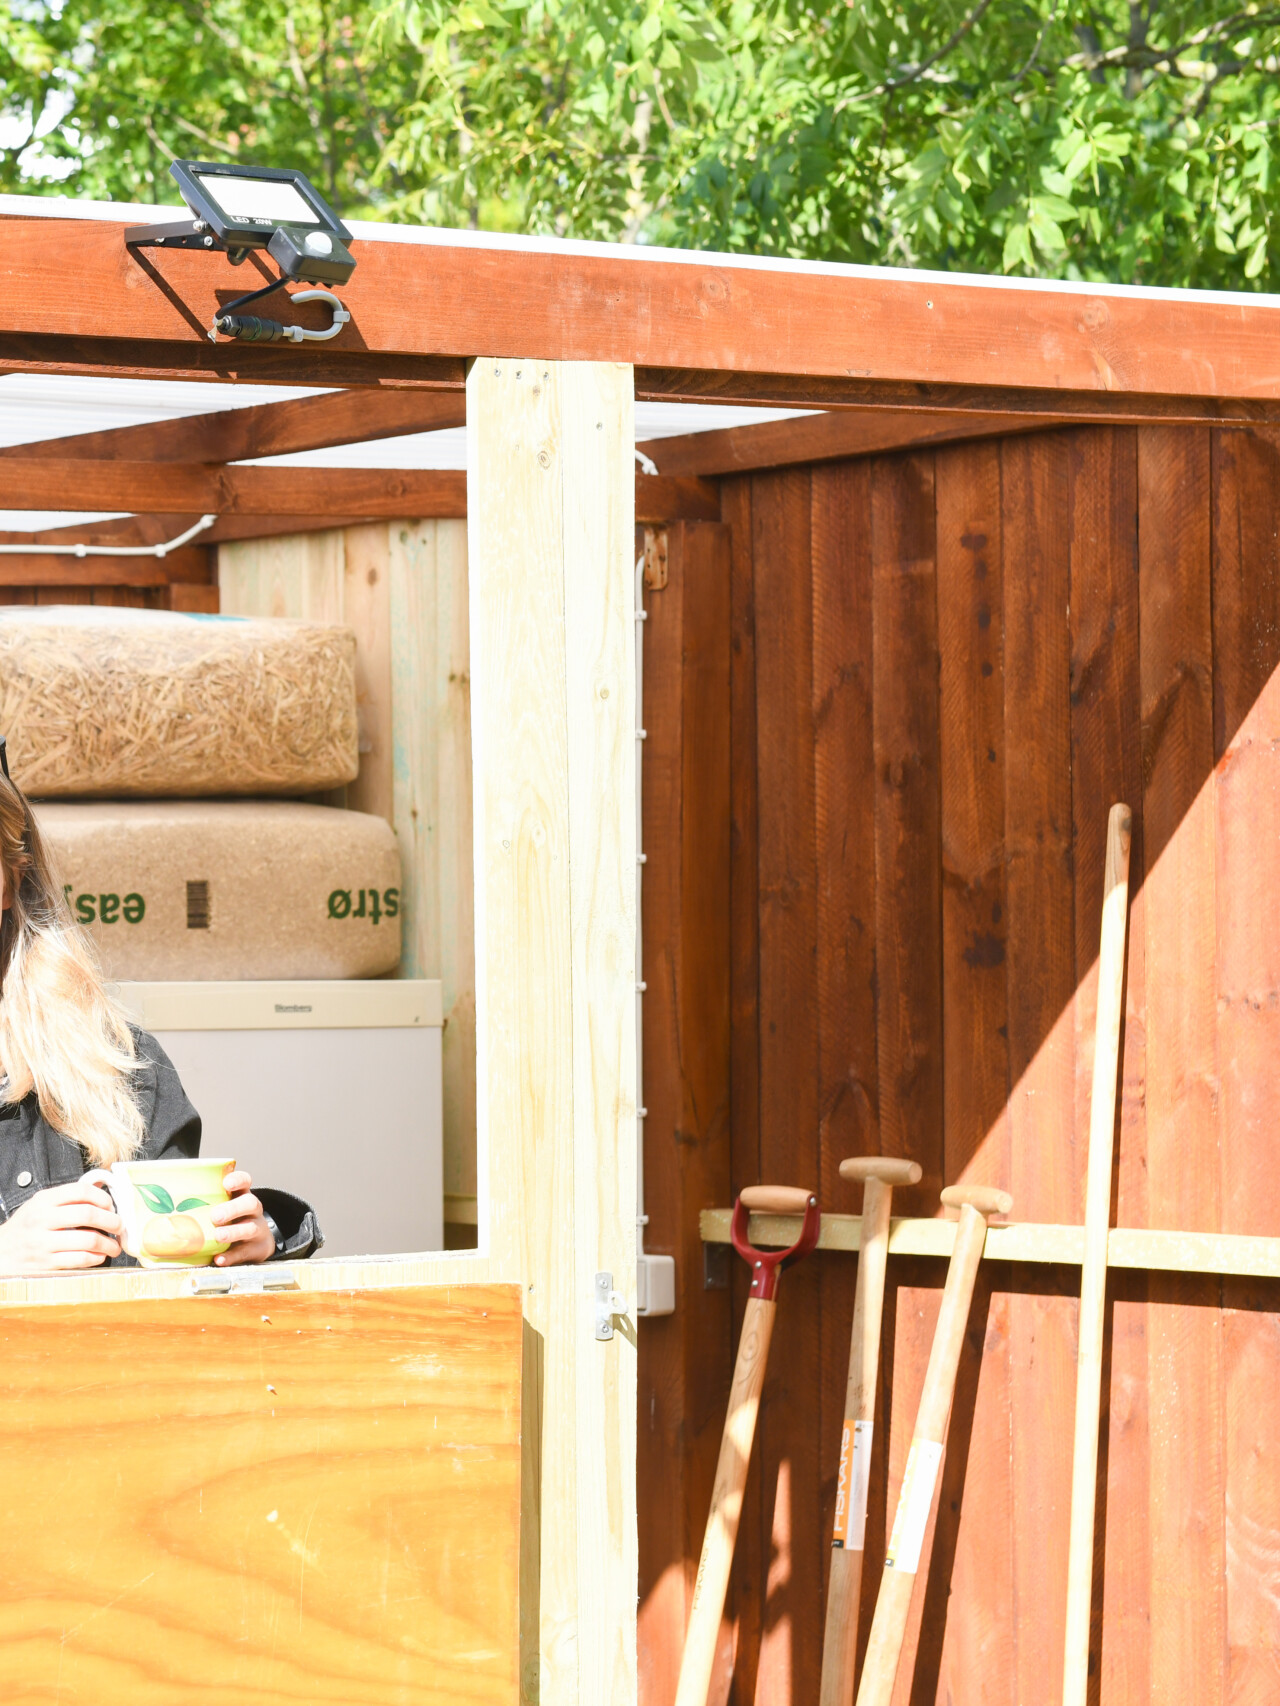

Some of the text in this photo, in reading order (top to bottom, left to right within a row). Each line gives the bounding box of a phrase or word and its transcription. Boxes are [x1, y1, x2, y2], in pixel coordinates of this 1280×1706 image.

[230, 215, 250, 224] LED
[327, 887, 400, 926] strø
[833, 1428, 851, 1532] FISKARS
